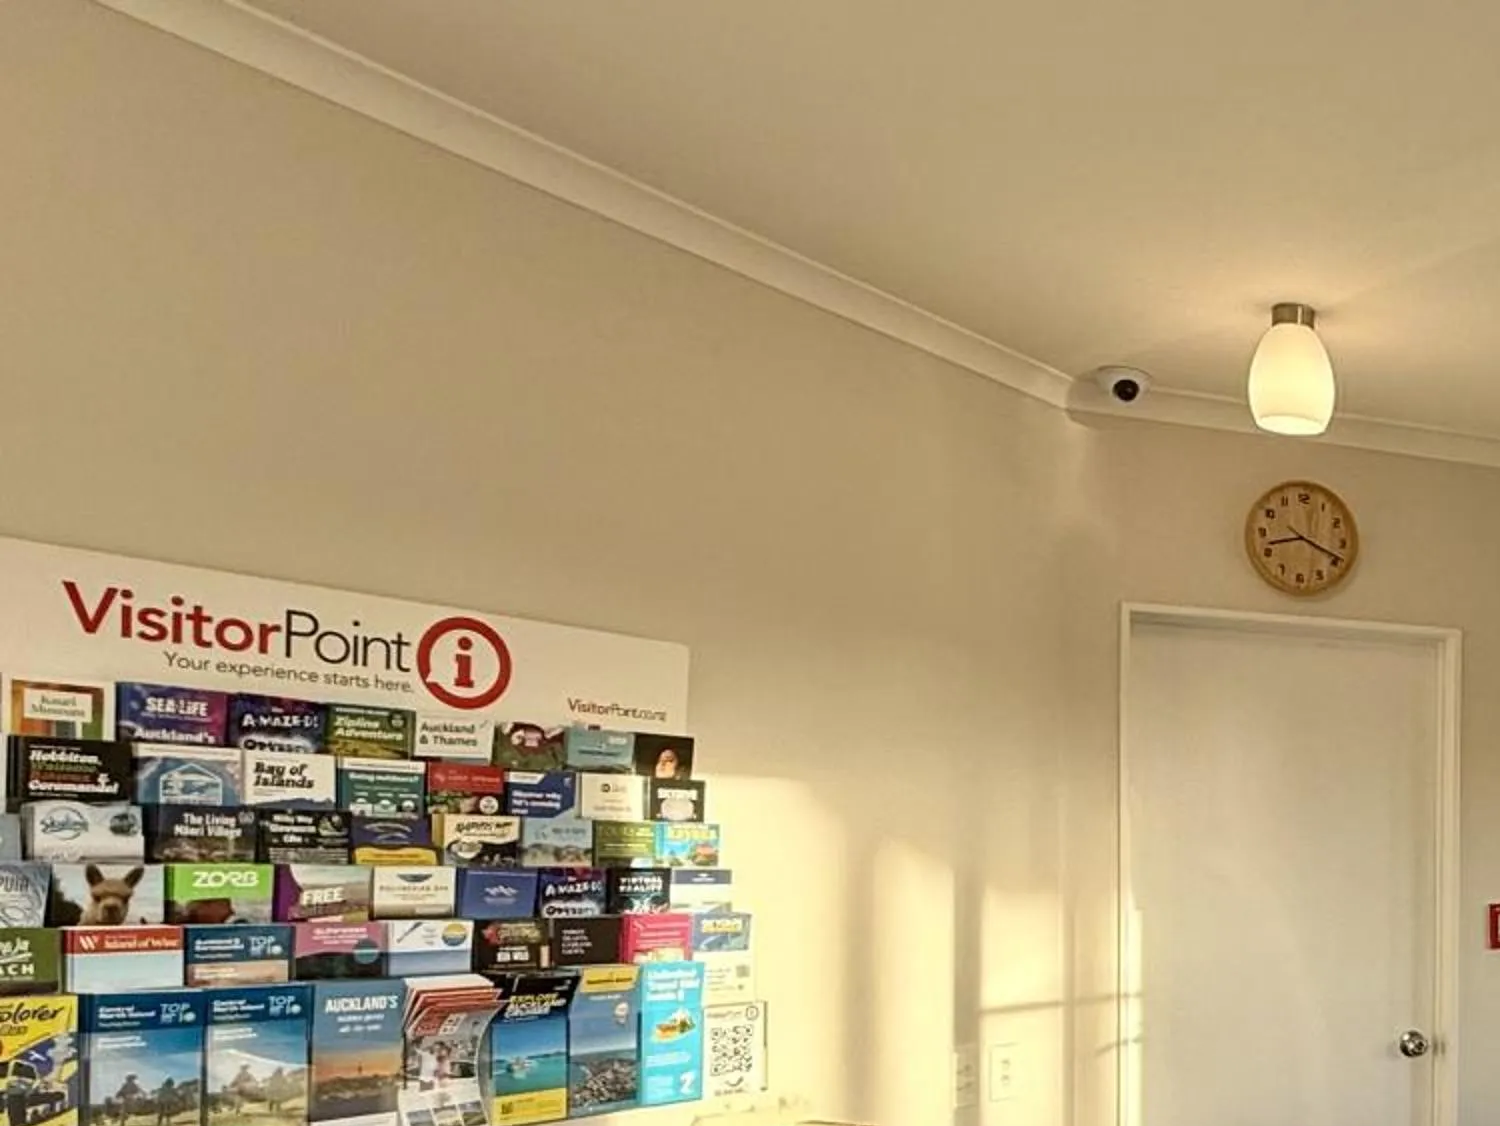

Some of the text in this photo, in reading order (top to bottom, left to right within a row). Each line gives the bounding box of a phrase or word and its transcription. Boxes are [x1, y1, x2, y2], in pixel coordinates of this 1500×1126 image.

[164, 651, 415, 693] Your experience starts here.
[145, 697, 176, 713] SEA
[421, 722, 476, 734] Auckland
[254, 761, 309, 777] Bay of
[253, 776, 315, 790] Islands
[182, 812, 237, 829] The Living
[192, 871, 259, 888] ZORB
[301, 886, 344, 906] FREE
[324, 995, 399, 1014] AUCKLAND'S
